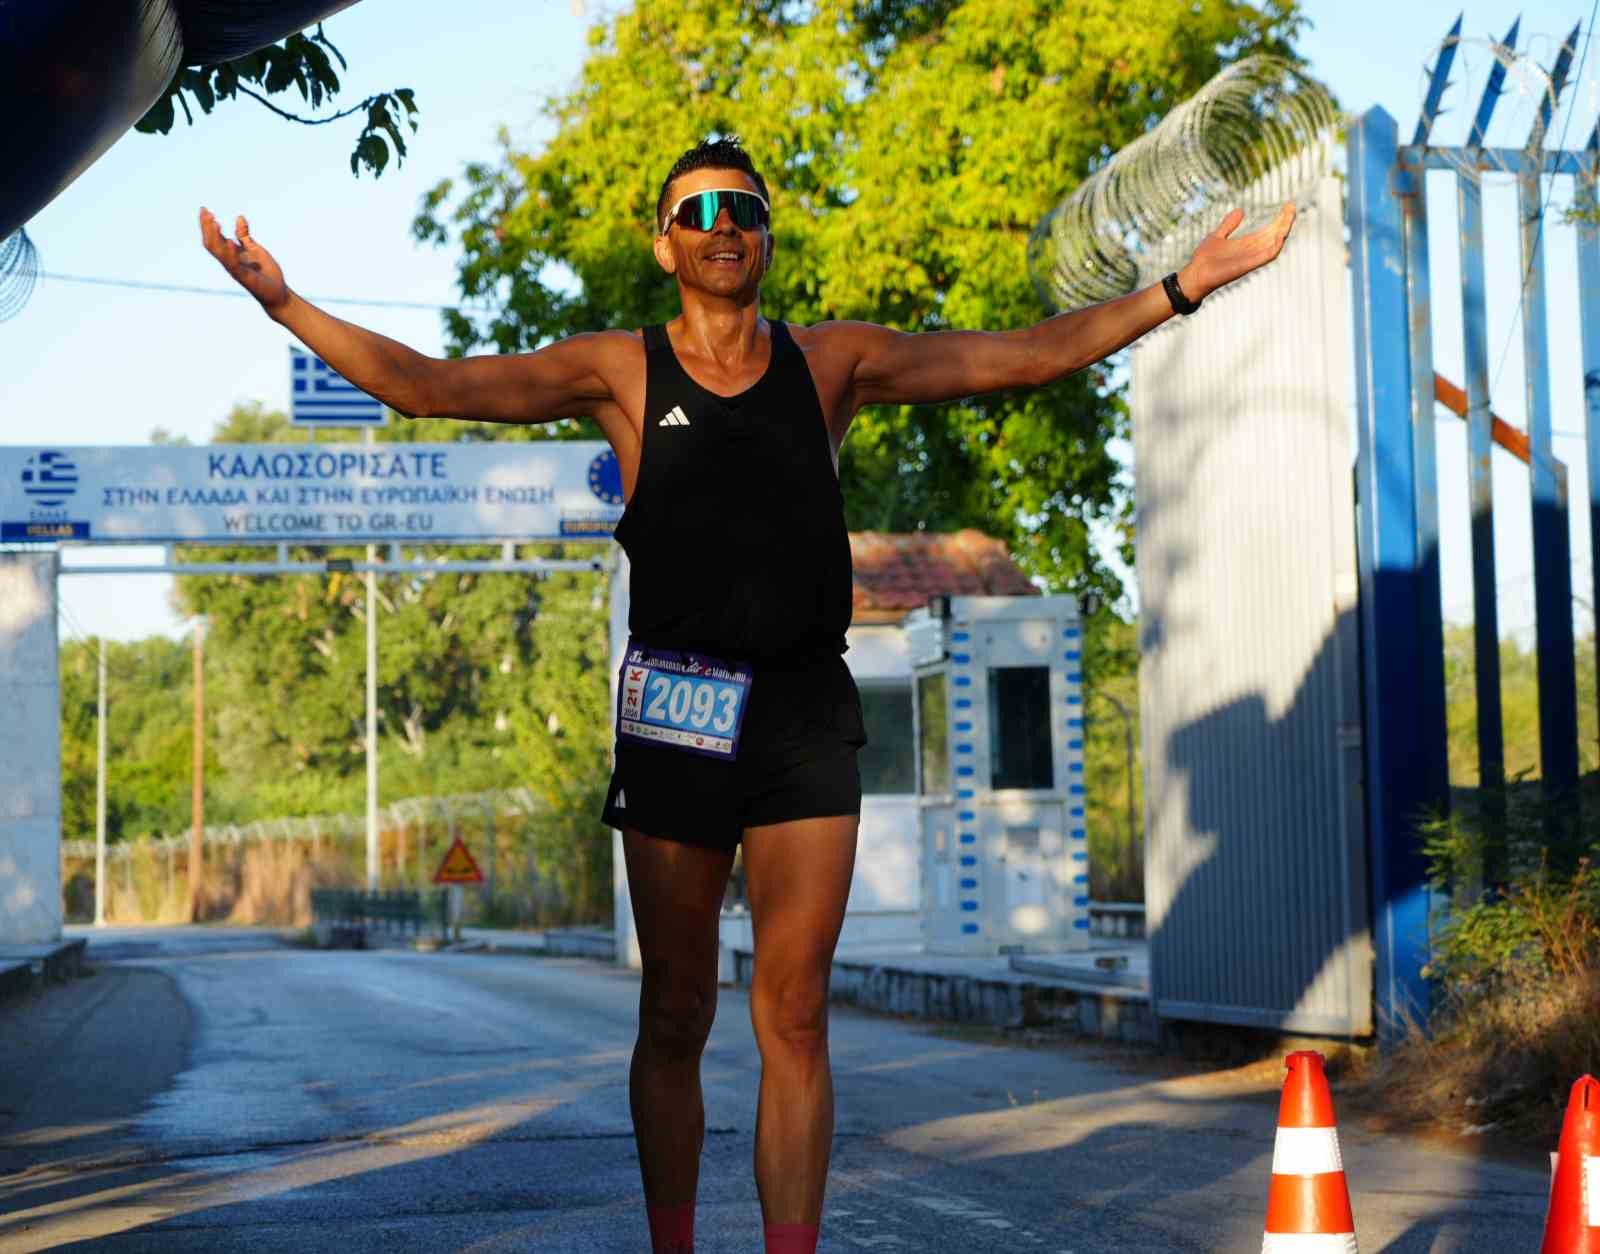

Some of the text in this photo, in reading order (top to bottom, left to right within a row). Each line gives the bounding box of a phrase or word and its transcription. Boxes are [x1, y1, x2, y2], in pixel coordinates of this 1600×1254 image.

[208, 453, 448, 479] ΚΑΛΩΣΟΡΙΣΑΤΕ
[103, 487, 159, 506] ΣΤΗΝ
[167, 487, 248, 505] ΕΛΛΑΔΑ
[257, 487, 290, 503] ΚΑΙ
[298, 486, 353, 505] ΣΤΗΝ
[224, 512, 433, 531] WELCOME TO GR-EU
[646, 677, 738, 732] 2093
